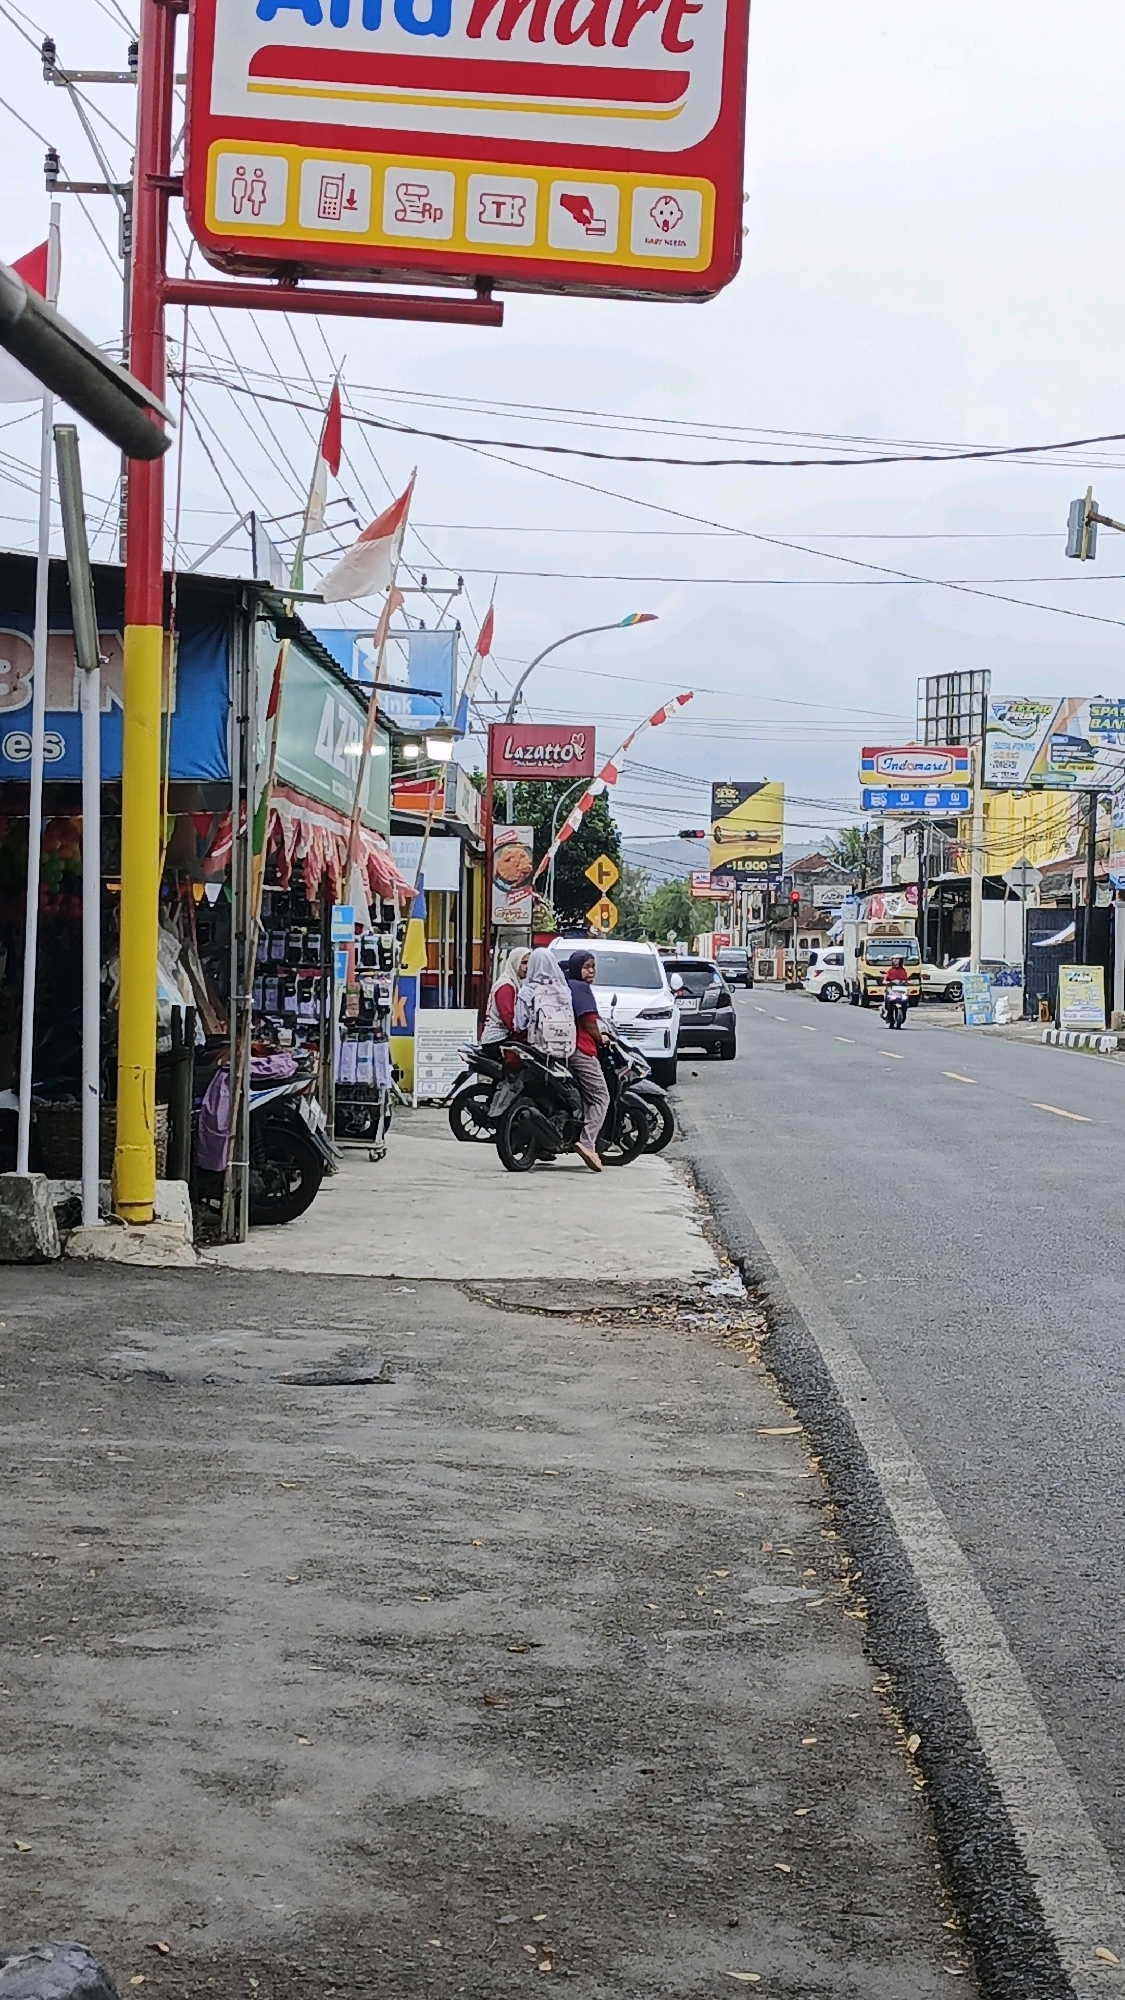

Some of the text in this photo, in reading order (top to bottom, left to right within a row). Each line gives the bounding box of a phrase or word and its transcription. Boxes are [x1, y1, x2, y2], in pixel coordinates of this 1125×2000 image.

[421, 203, 443, 223] Rp
[1090, 718, 1125, 730] BAN
[504, 735, 574, 761] Lazatto
[880, 757, 949, 771] Indomaret
